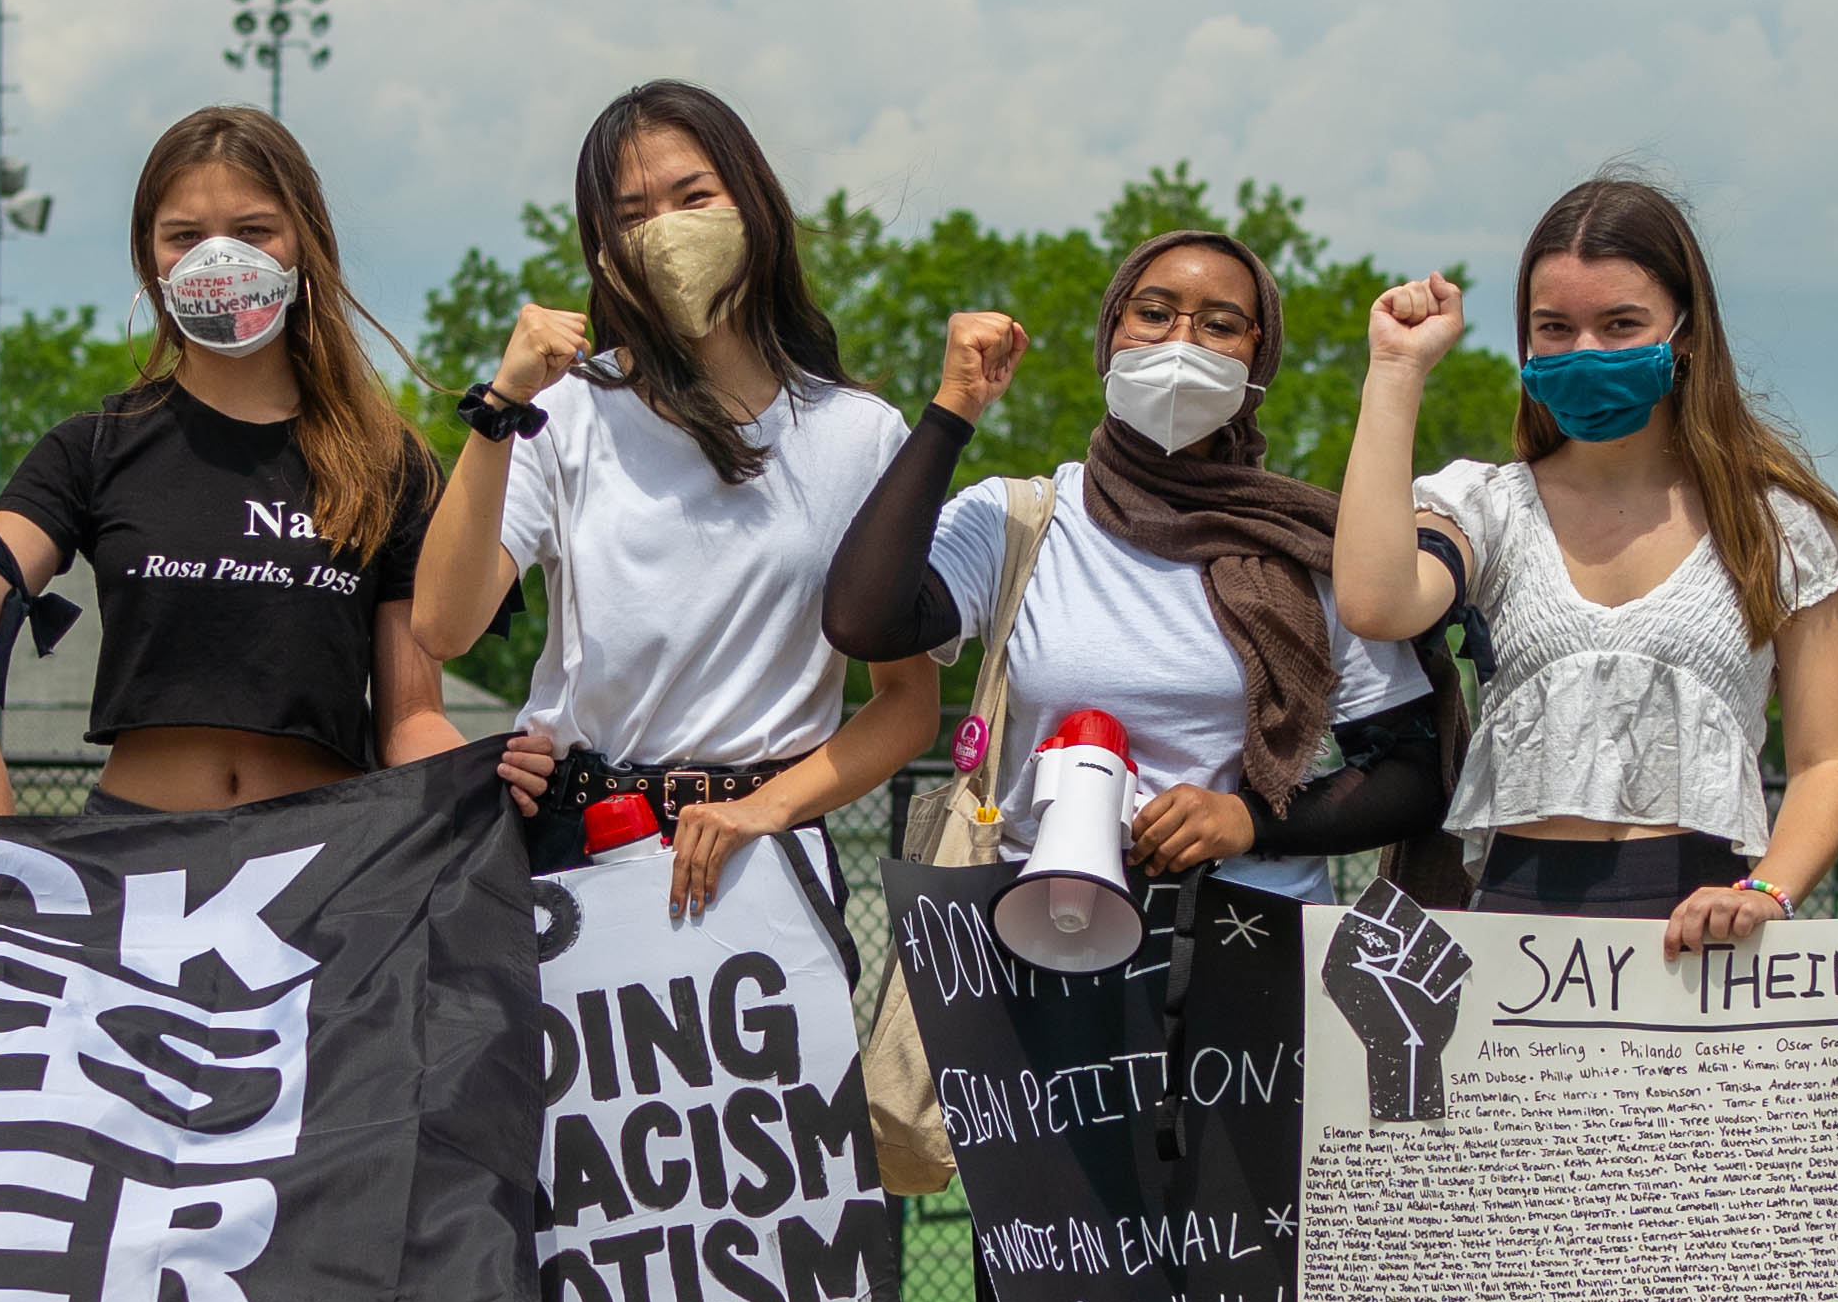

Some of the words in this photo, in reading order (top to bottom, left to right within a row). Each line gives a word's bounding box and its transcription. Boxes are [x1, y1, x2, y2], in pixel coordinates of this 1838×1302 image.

[184, 276, 233, 287] LATINAS
[242, 271, 258, 282] IN
[177, 287, 204, 297] FAVOR
[142, 555, 206, 578] Rosa
[212, 558, 295, 588] Parks,
[303, 565, 360, 596] 1955
[1498, 935, 1634, 1014] SAY
[1478, 1040, 1520, 1061] Alton
[1528, 1042, 1585, 1062] Sterling
[1621, 1041, 1682, 1059] Philando
[1695, 1042, 1745, 1056] Castile
[1777, 1038, 1813, 1052] Oscar
[1485, 1071, 1526, 1084] Dubose
[1540, 1069, 1573, 1083] Phillip
[1743, 1059, 1779, 1070] Kimani
[1785, 1059, 1810, 1072] Gray
[1450, 1091, 1521, 1104] Chamberlain
[1535, 1091, 1556, 1102] Eric
[1563, 1091, 1597, 1100] Harris
[1613, 1090, 1639, 1100] Tony
[1646, 1087, 1701, 1097] Robinson
[1716, 1081, 1762, 1093] Tanisha
[1768, 1079, 1820, 1090] Anderson
[940, 1068, 1017, 1146] SIGN
[1447, 1105, 1470, 1119] Eric
[1476, 1106, 1511, 1117] Garner
[1557, 1107, 1609, 1117] Hamilton
[1619, 1104, 1664, 1118] Trayvon
[1667, 1103, 1706, 1113] Martin
[1762, 1098, 1769, 1107] E
[1775, 1095, 1795, 1105] Rice
[1323, 1126, 1364, 1139] Eleanor
[1494, 1121, 1532, 1132] Rumain
[1582, 1119, 1606, 1129] John
[1657, 1117, 1668, 1128] III
[1715, 1114, 1758, 1124] Woodson
[536, 1050, 882, 1233] ACISM
[994, 1218, 1064, 1274] WRITE
[1069, 1217, 1110, 1275] AN
[1117, 1211, 1262, 1275] EMAIL
